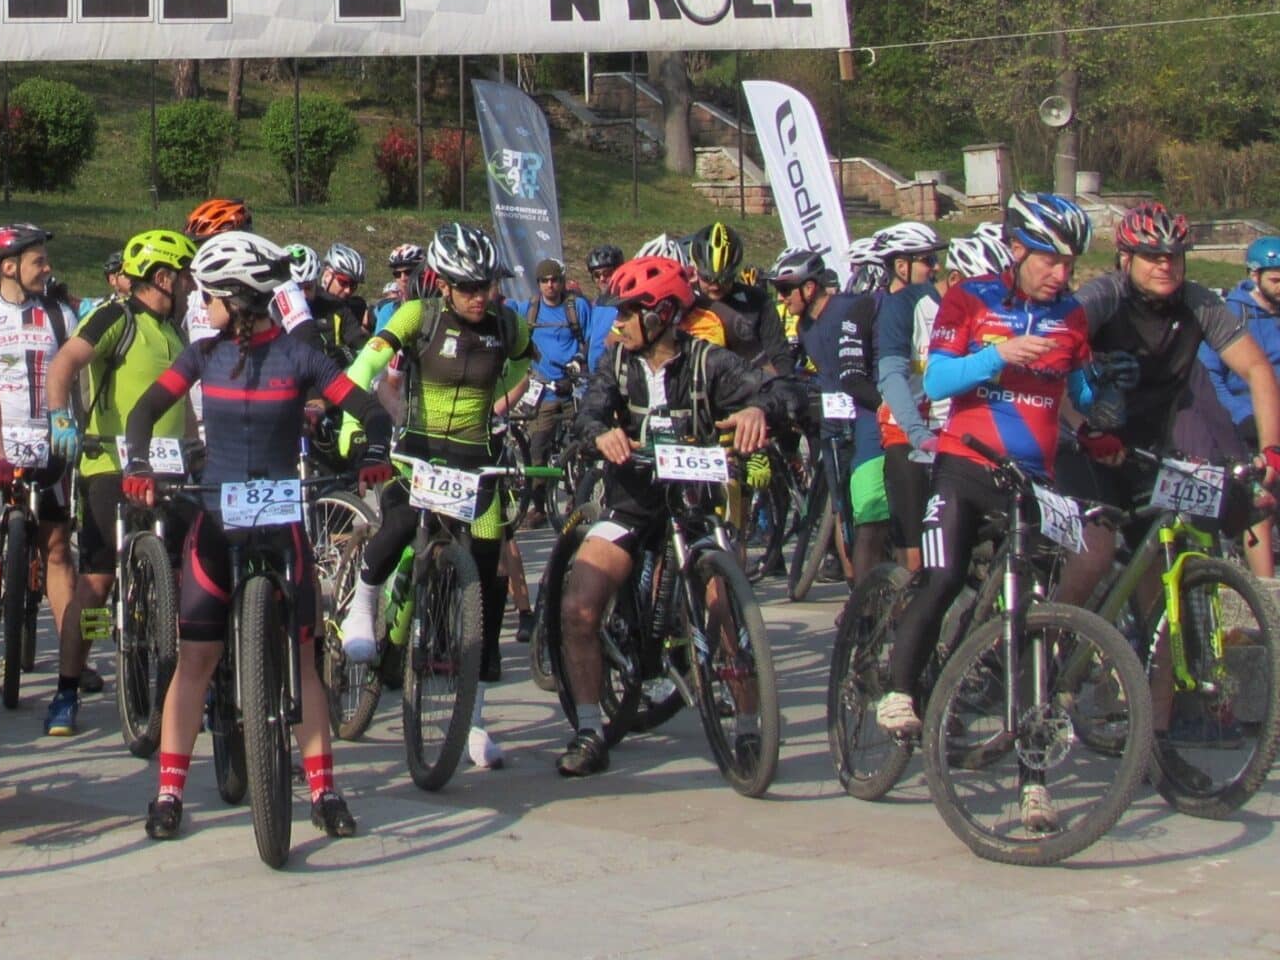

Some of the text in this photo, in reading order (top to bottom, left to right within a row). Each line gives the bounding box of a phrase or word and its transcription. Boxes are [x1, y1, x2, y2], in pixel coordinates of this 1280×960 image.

[1017, 393, 1054, 408] NOR
[673, 455, 710, 470] 165
[246, 487, 275, 504] 82
[428, 476, 462, 500] 148
